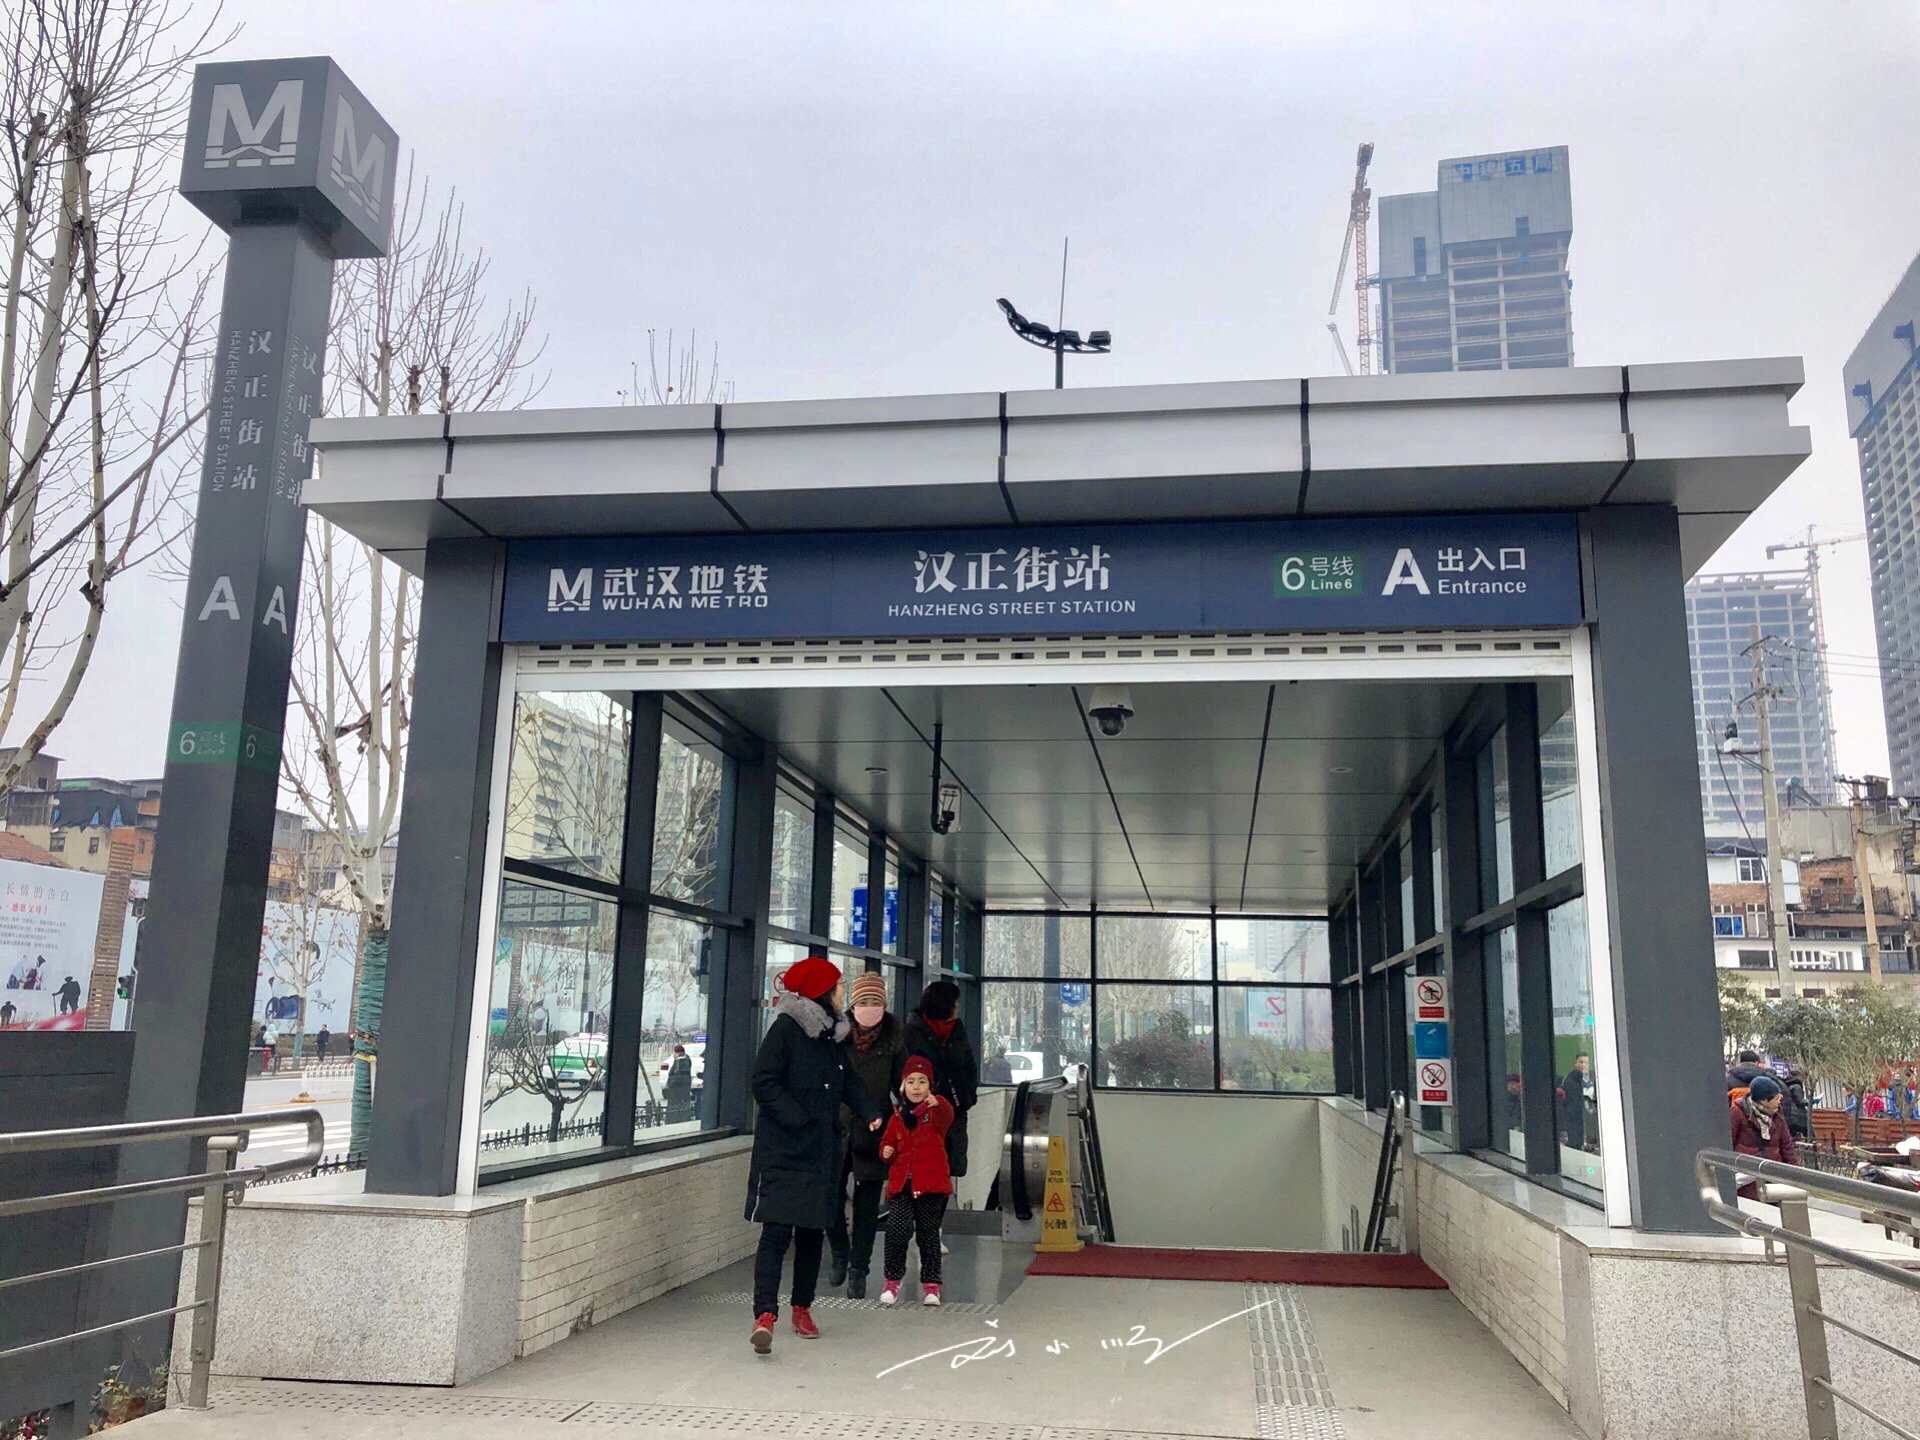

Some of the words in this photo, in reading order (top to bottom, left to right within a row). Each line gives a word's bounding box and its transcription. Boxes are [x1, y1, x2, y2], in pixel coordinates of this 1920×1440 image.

[224, 330, 242, 393] HANZHENG
[219, 395, 235, 440] STREET
[231, 329, 273, 490] 汉正街站
[212, 443, 231, 492] STATION
[603, 564, 768, 596] 武汉地铁
[913, 544, 1111, 593] 汉正街站
[1381, 548, 1431, 596] A
[1437, 547, 1526, 572] 出入口
[198, 575, 240, 621] A
[602, 597, 683, 611] WUHAN
[691, 595, 768, 609] METRO
[888, 602, 983, 616] HANZHENG
[988, 601, 1056, 615] STREET
[1061, 599, 1136, 614] STATION
[1438, 578, 1527, 595] Entrance
[262, 584, 288, 635] A
[180, 730, 196, 755] 6
